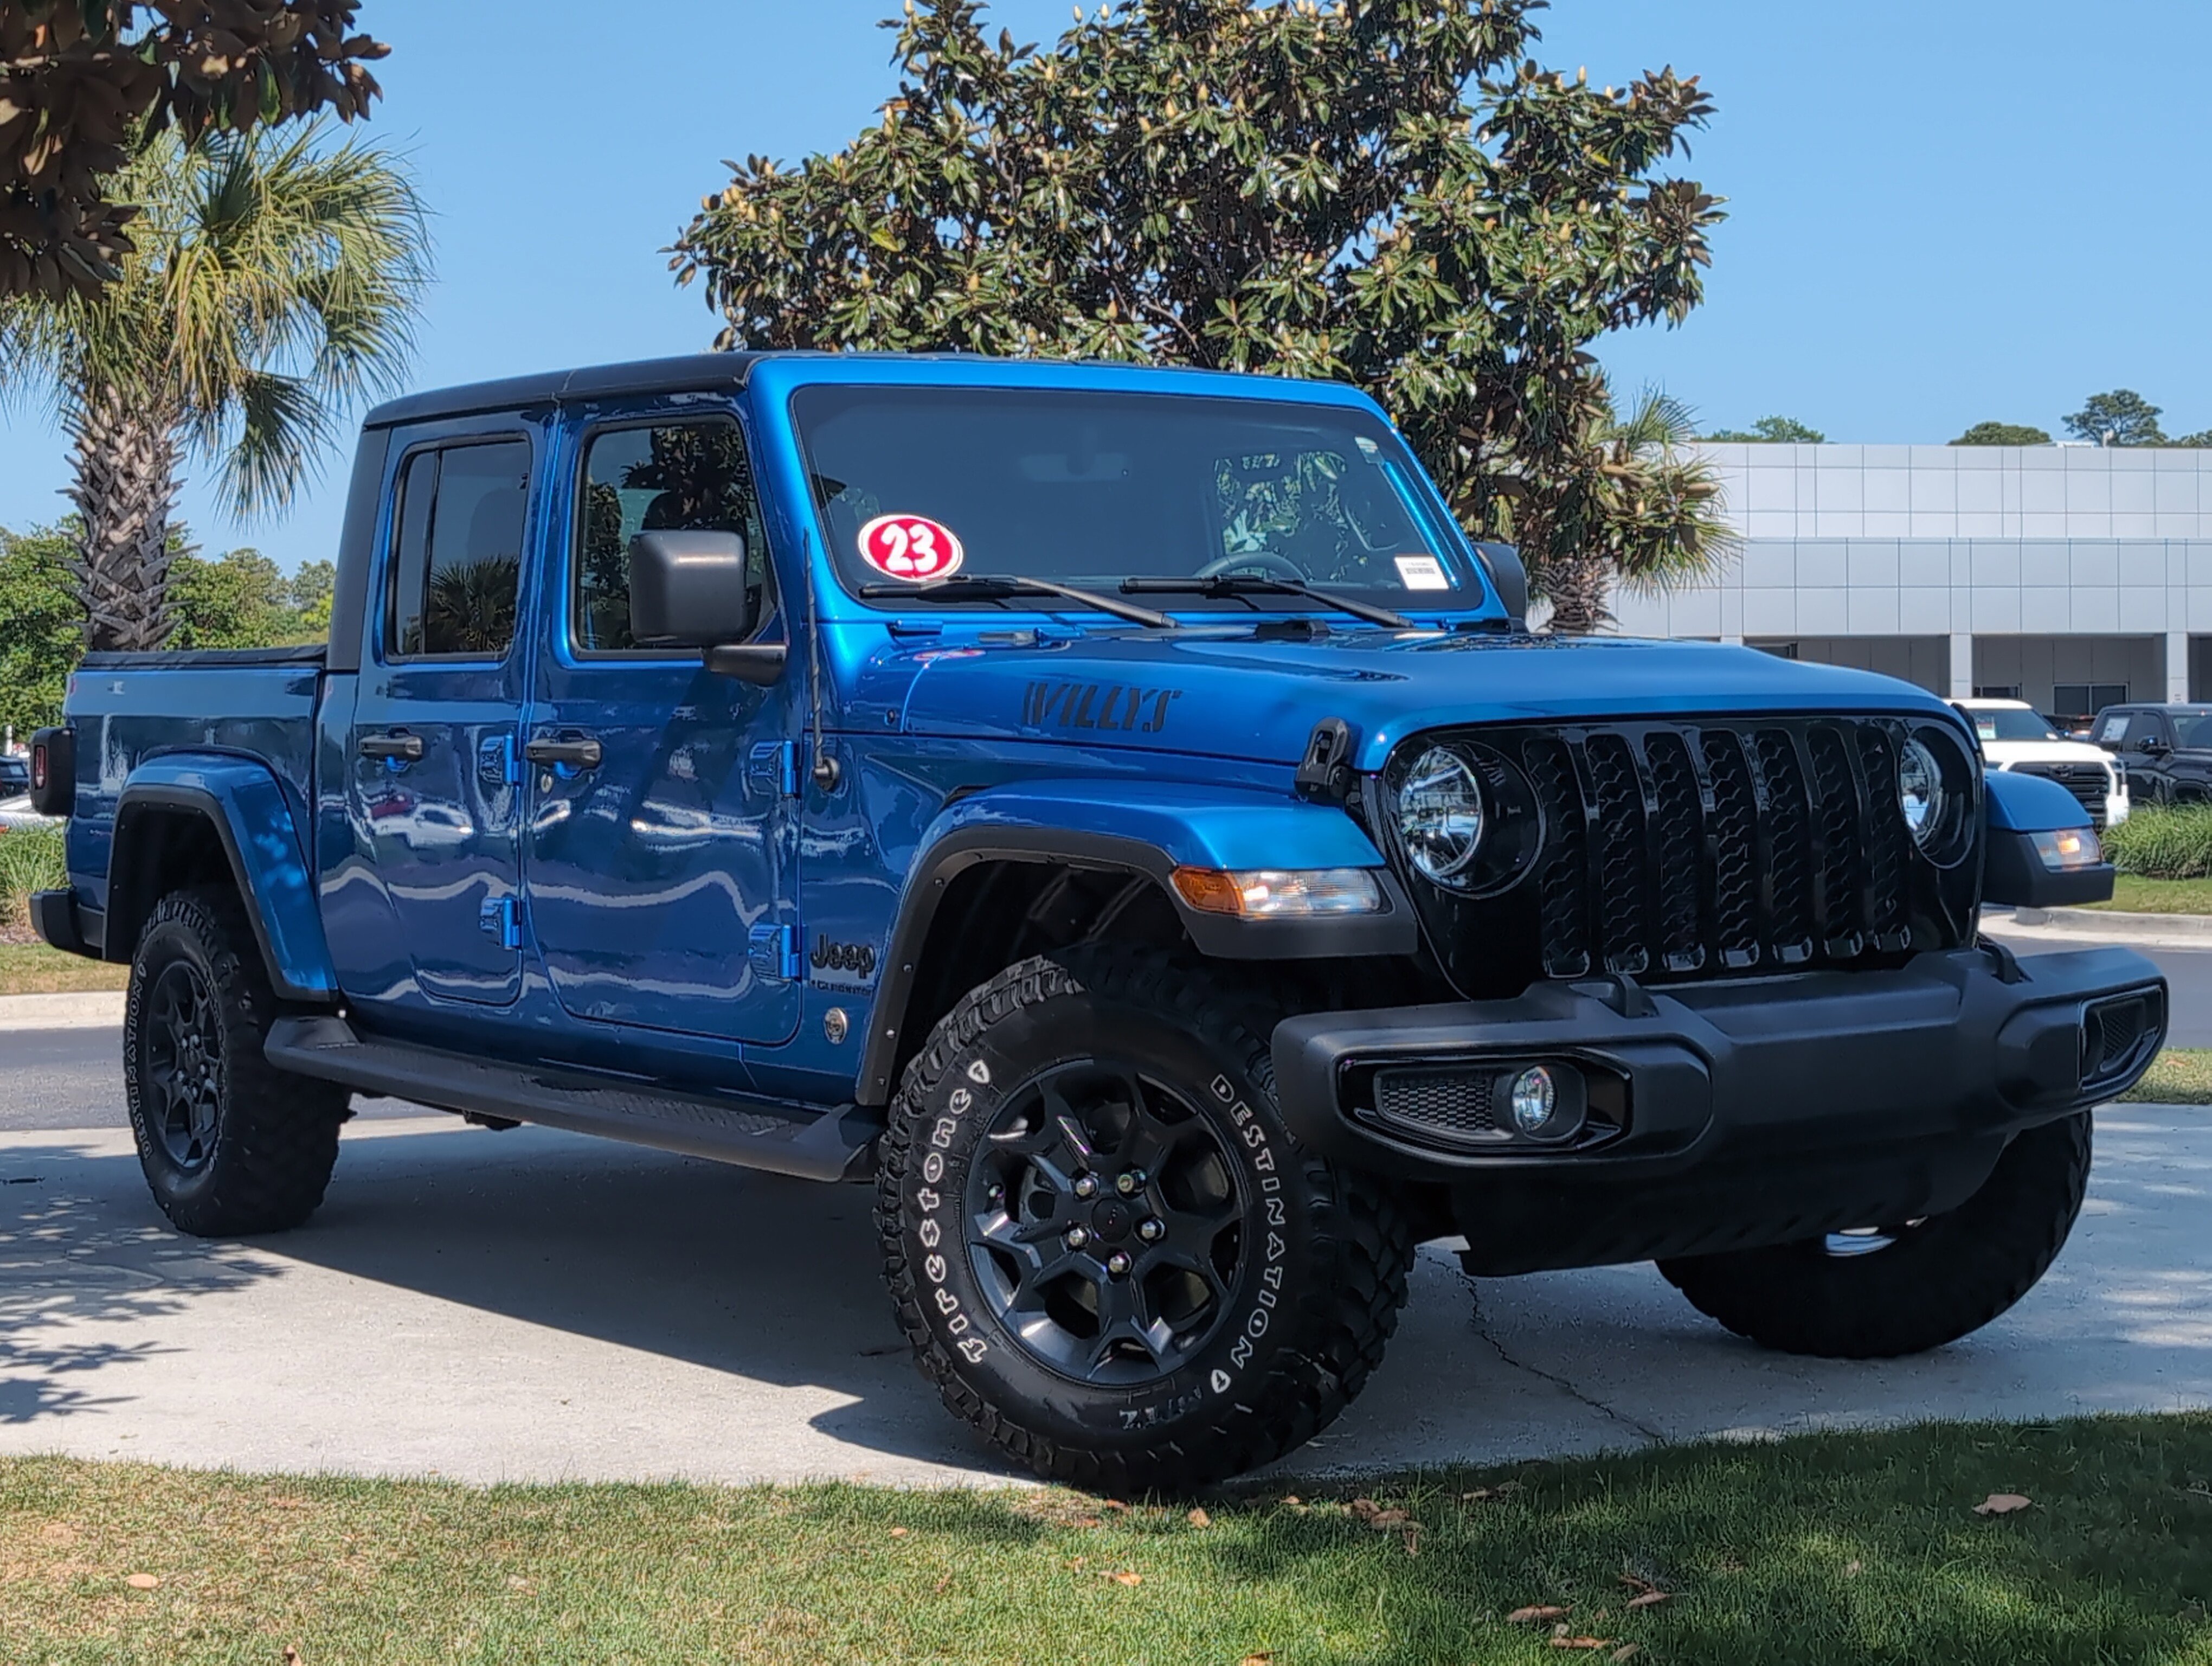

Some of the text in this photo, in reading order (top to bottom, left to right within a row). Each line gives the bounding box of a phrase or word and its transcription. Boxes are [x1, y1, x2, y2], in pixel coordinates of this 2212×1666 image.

[880, 523, 938, 573] 23
[1023, 682, 1183, 732] WILLYS
[810, 933, 876, 979] Jeep
[917, 1088, 987, 1363] Firestone
[1211, 1074, 1285, 1370] DESTINATION
